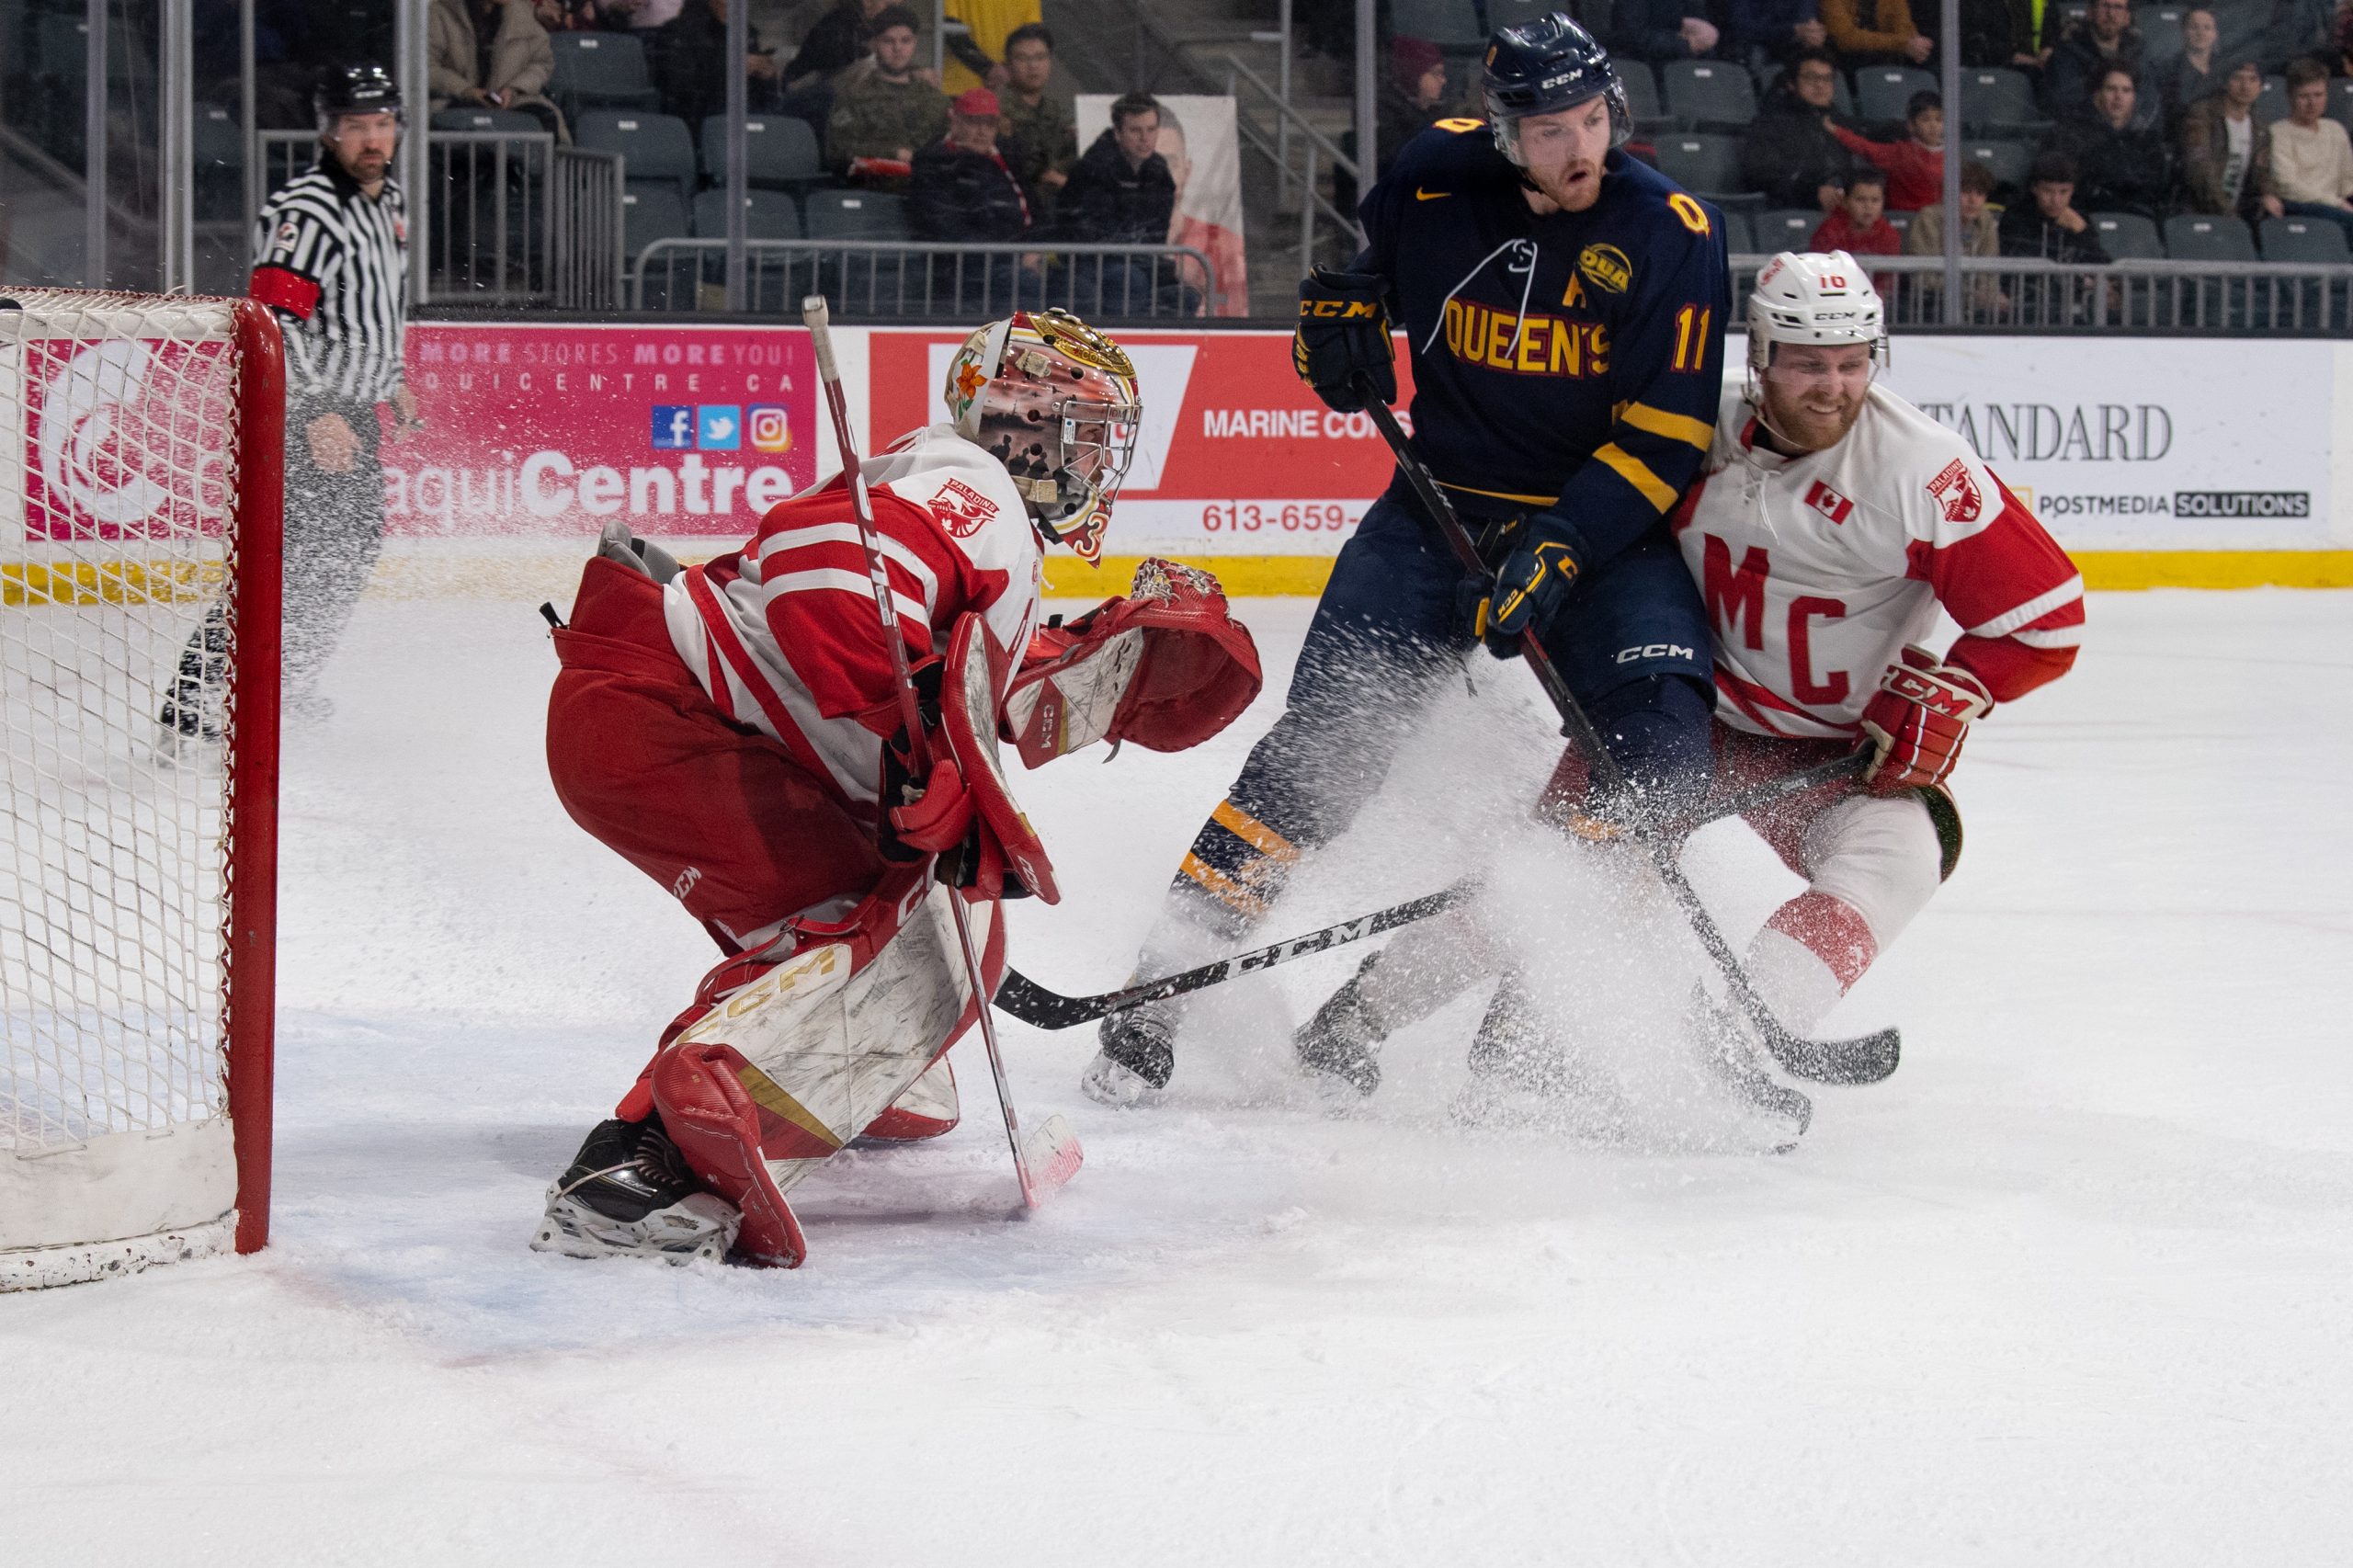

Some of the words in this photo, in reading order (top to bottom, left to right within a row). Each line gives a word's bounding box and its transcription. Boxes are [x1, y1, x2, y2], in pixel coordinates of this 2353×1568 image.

[1541, 67, 1584, 90] CCM
[1579, 248, 1631, 294] OUA
[1300, 299, 1378, 319] CCM
[1814, 311, 1856, 321] CCM
[420, 342, 512, 363] MORE
[632, 343, 726, 366] MORE
[733, 344, 794, 366] YOU!
[1443, 297, 1611, 378] QUEEN'S
[1673, 305, 1711, 372] 11
[1202, 409, 1320, 438] MARINE
[1916, 402, 2173, 461] TANDARD
[1929, 460, 1964, 494] PALADINS
[949, 479, 998, 514] PALADINS
[2039, 495, 2170, 515] POSTMEDIA
[2176, 494, 2310, 517] SOLUTIONS
[1497, 587, 1518, 617] CCM
[1615, 644, 1695, 665] CCM
[1881, 665, 1973, 717] CM
[1040, 704, 1054, 749] CCM
[1225, 918, 1374, 980] CCM
